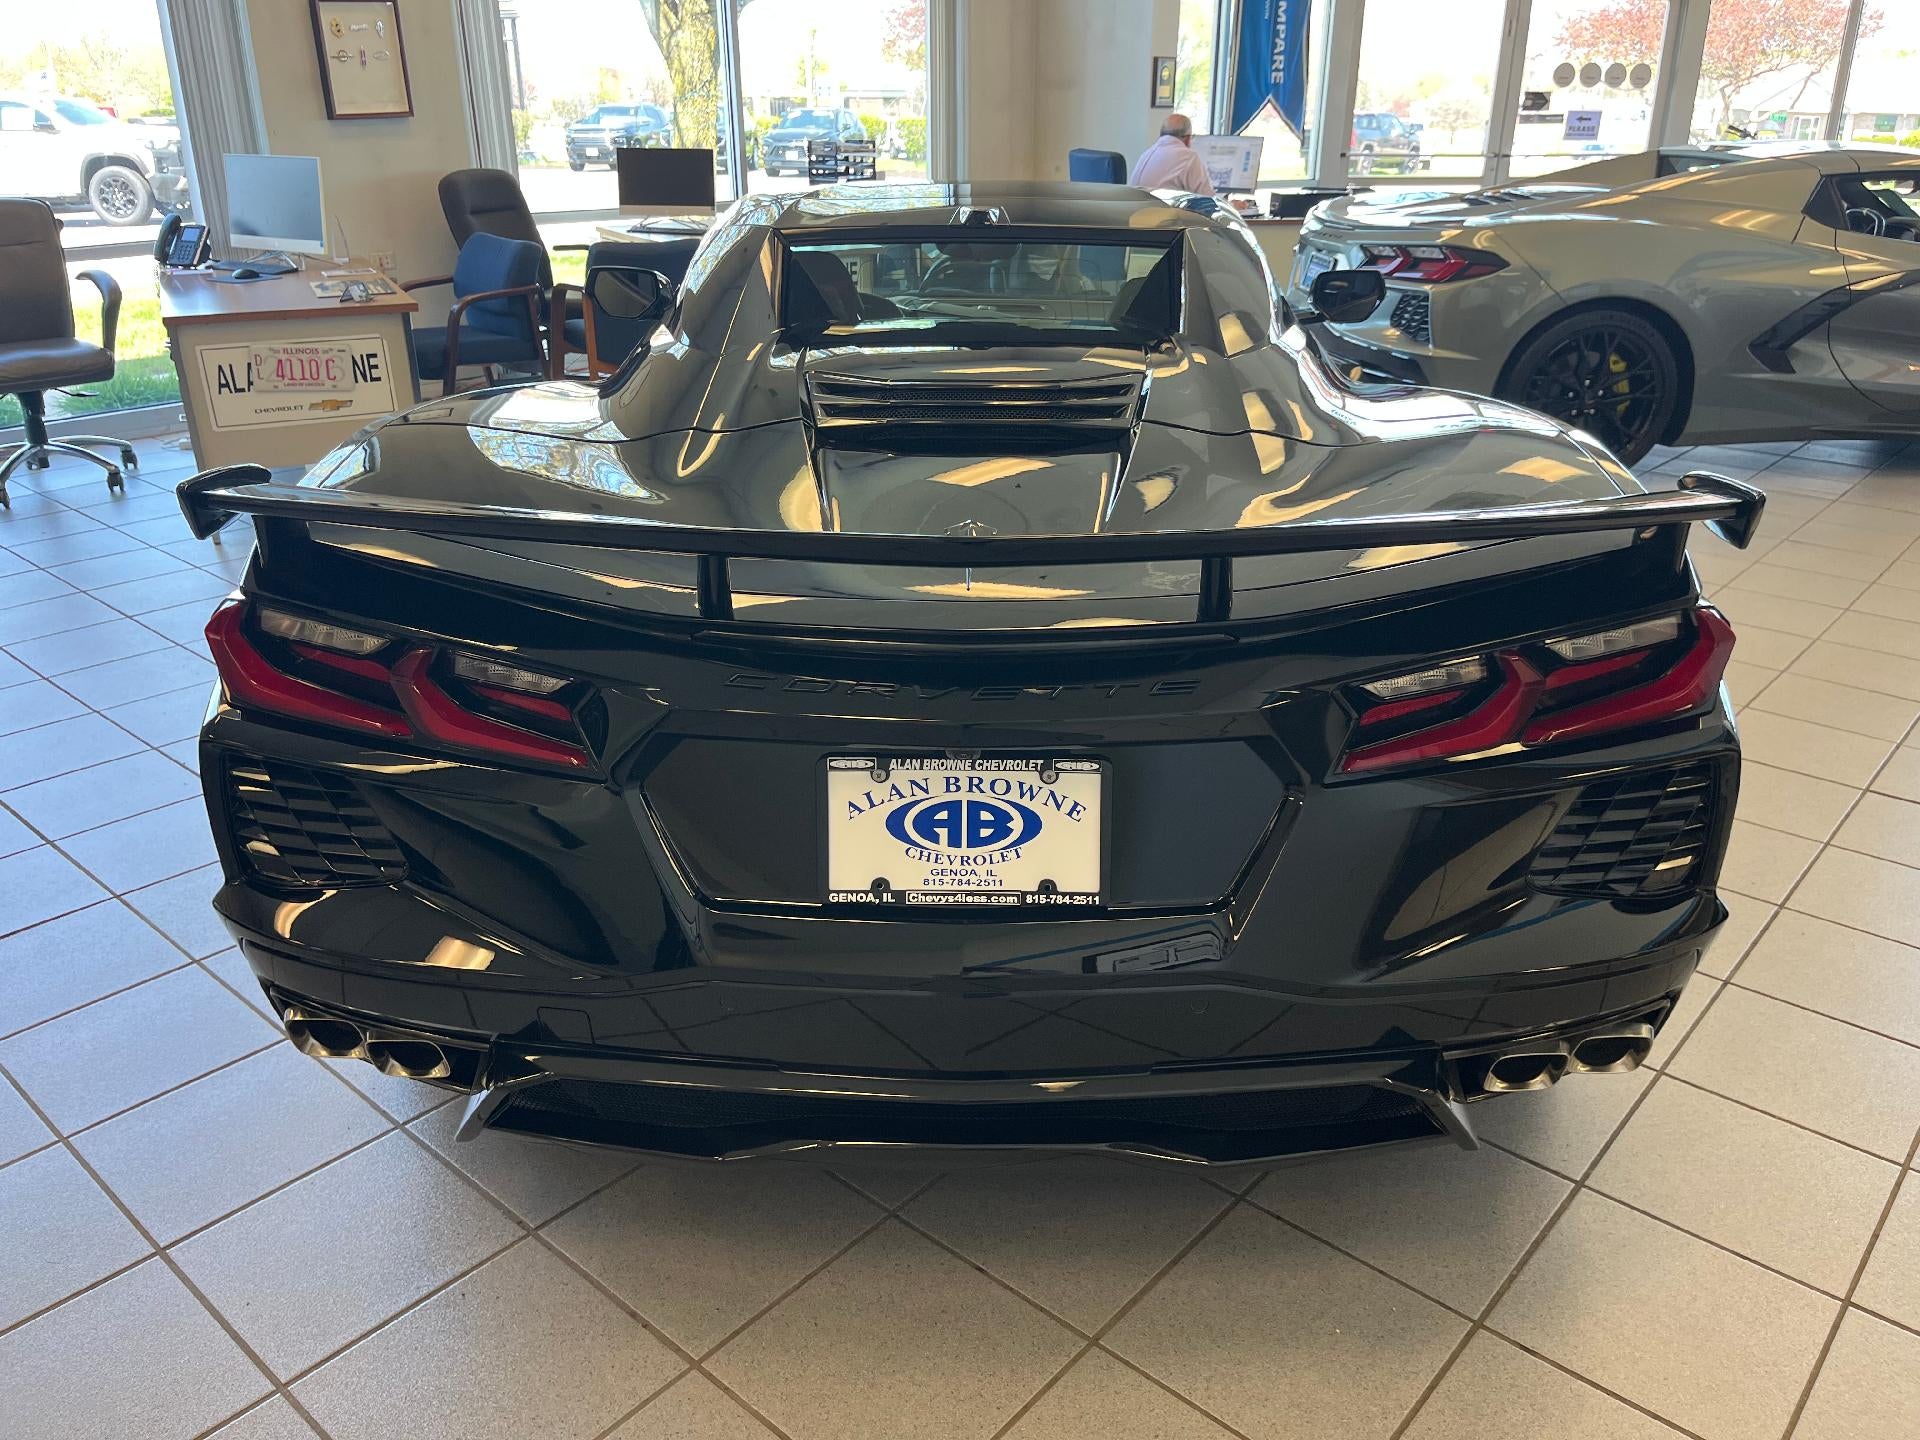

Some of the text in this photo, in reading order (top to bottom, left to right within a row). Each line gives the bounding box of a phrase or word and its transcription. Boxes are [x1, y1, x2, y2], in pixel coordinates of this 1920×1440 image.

[283, 347, 320, 355] ILLINOIS
[276, 358, 320, 381] 4110
[254, 404, 304, 415] CHEVROLET
[724, 672, 1200, 701] CORVETTE
[889, 758, 922, 771] ALAN
[922, 758, 973, 772] BROWNE
[974, 759, 1044, 772] CHEVROLET
[847, 775, 1088, 823] ALAN BROWNE
[904, 846, 1023, 867] CHEVROLET
[930, 868, 998, 878] GENOA, IL
[922, 878, 1004, 887] 815-784-2511
[828, 892, 1100, 905] GENOA, IL Chevys4less.com 815-784-2511
